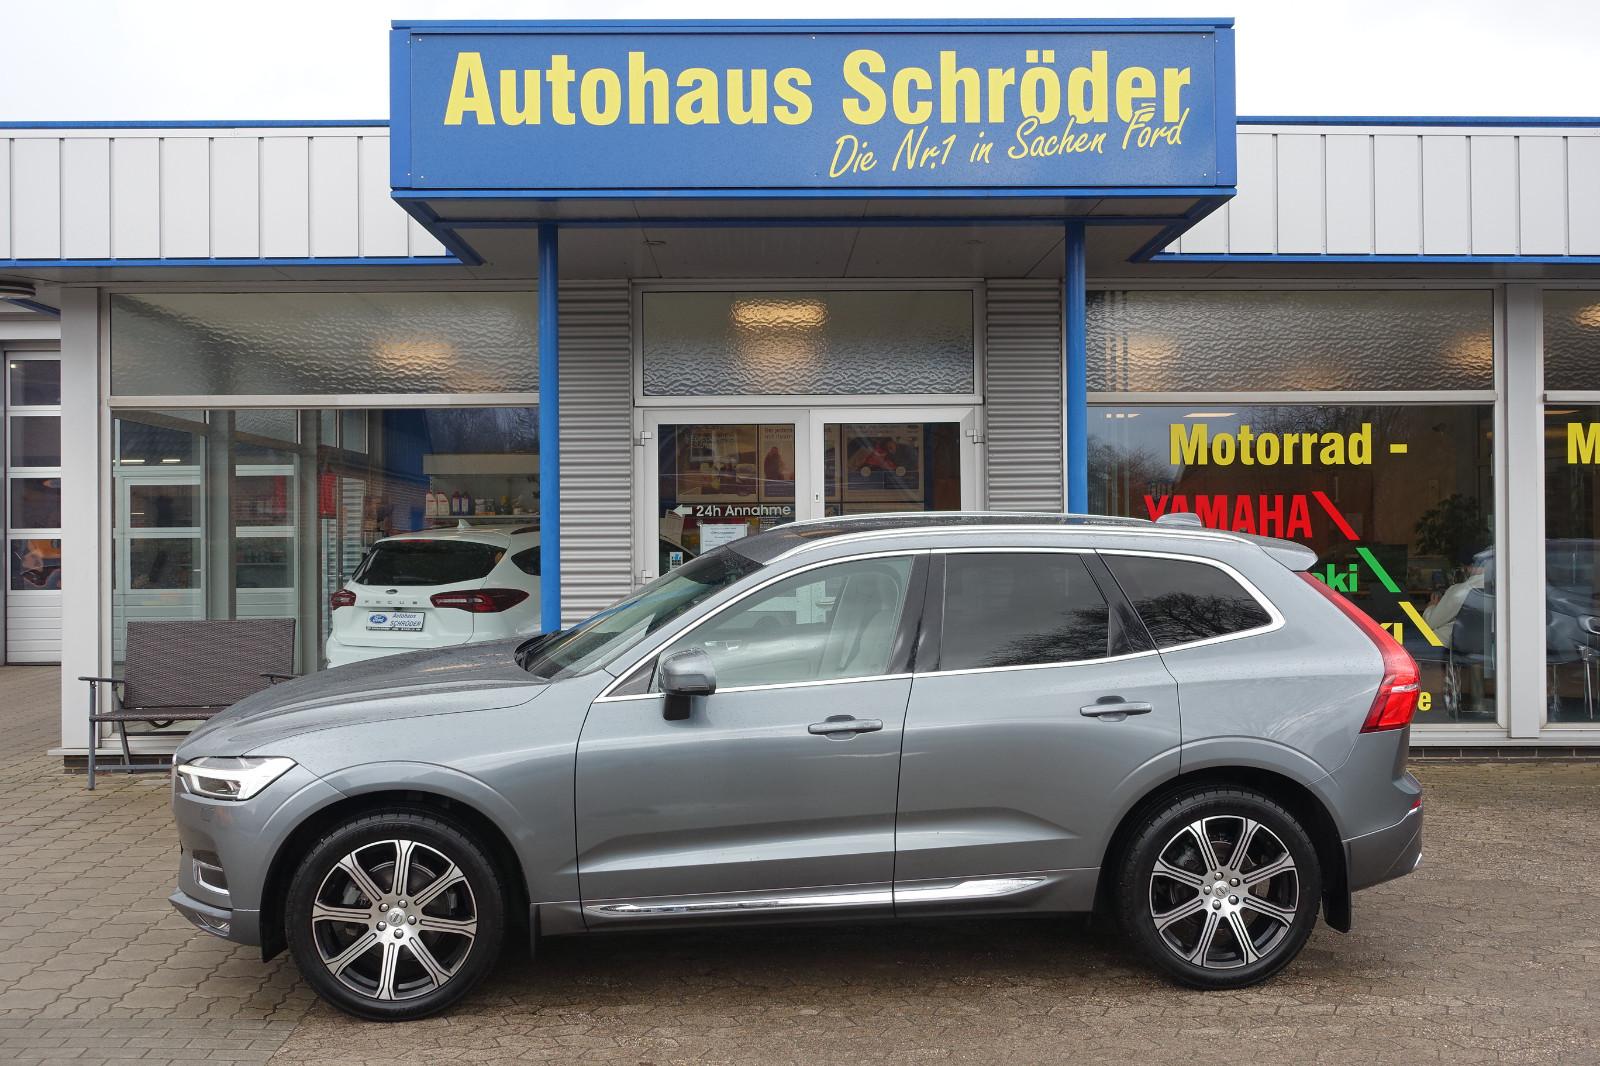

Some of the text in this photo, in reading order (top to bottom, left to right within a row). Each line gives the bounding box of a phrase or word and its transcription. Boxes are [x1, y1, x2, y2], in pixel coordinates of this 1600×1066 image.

[445, 49, 1191, 126] Autohaus Schröder
[829, 103, 1190, 178] Die Nr.1 in Sachen Ford
[1169, 422, 1372, 466] Motorrad
[696, 504, 792, 517] 24h Annahme
